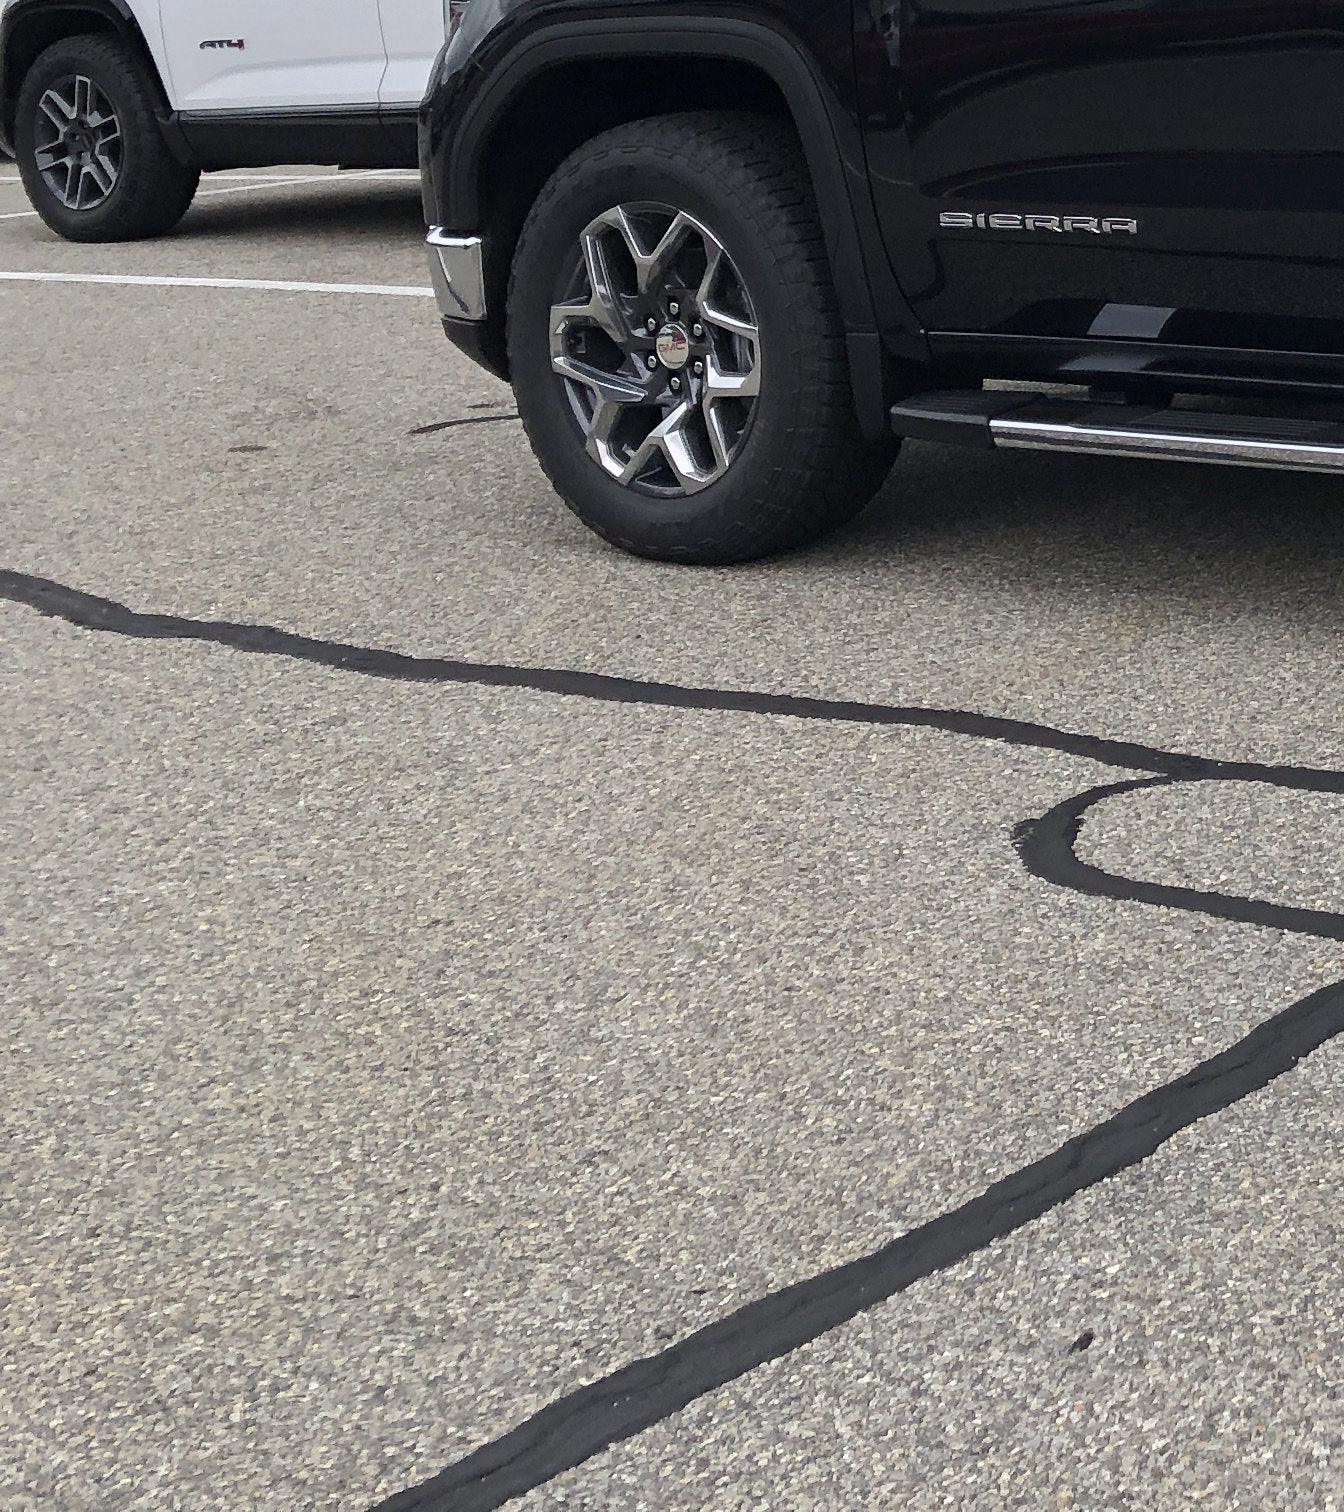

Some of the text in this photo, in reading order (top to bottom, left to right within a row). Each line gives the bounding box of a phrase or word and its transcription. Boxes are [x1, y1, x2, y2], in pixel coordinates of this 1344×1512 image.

[199, 39, 245, 50] AT4
[939, 212, 1138, 234] SIERRA
[640, 506, 690, 546] GMC
